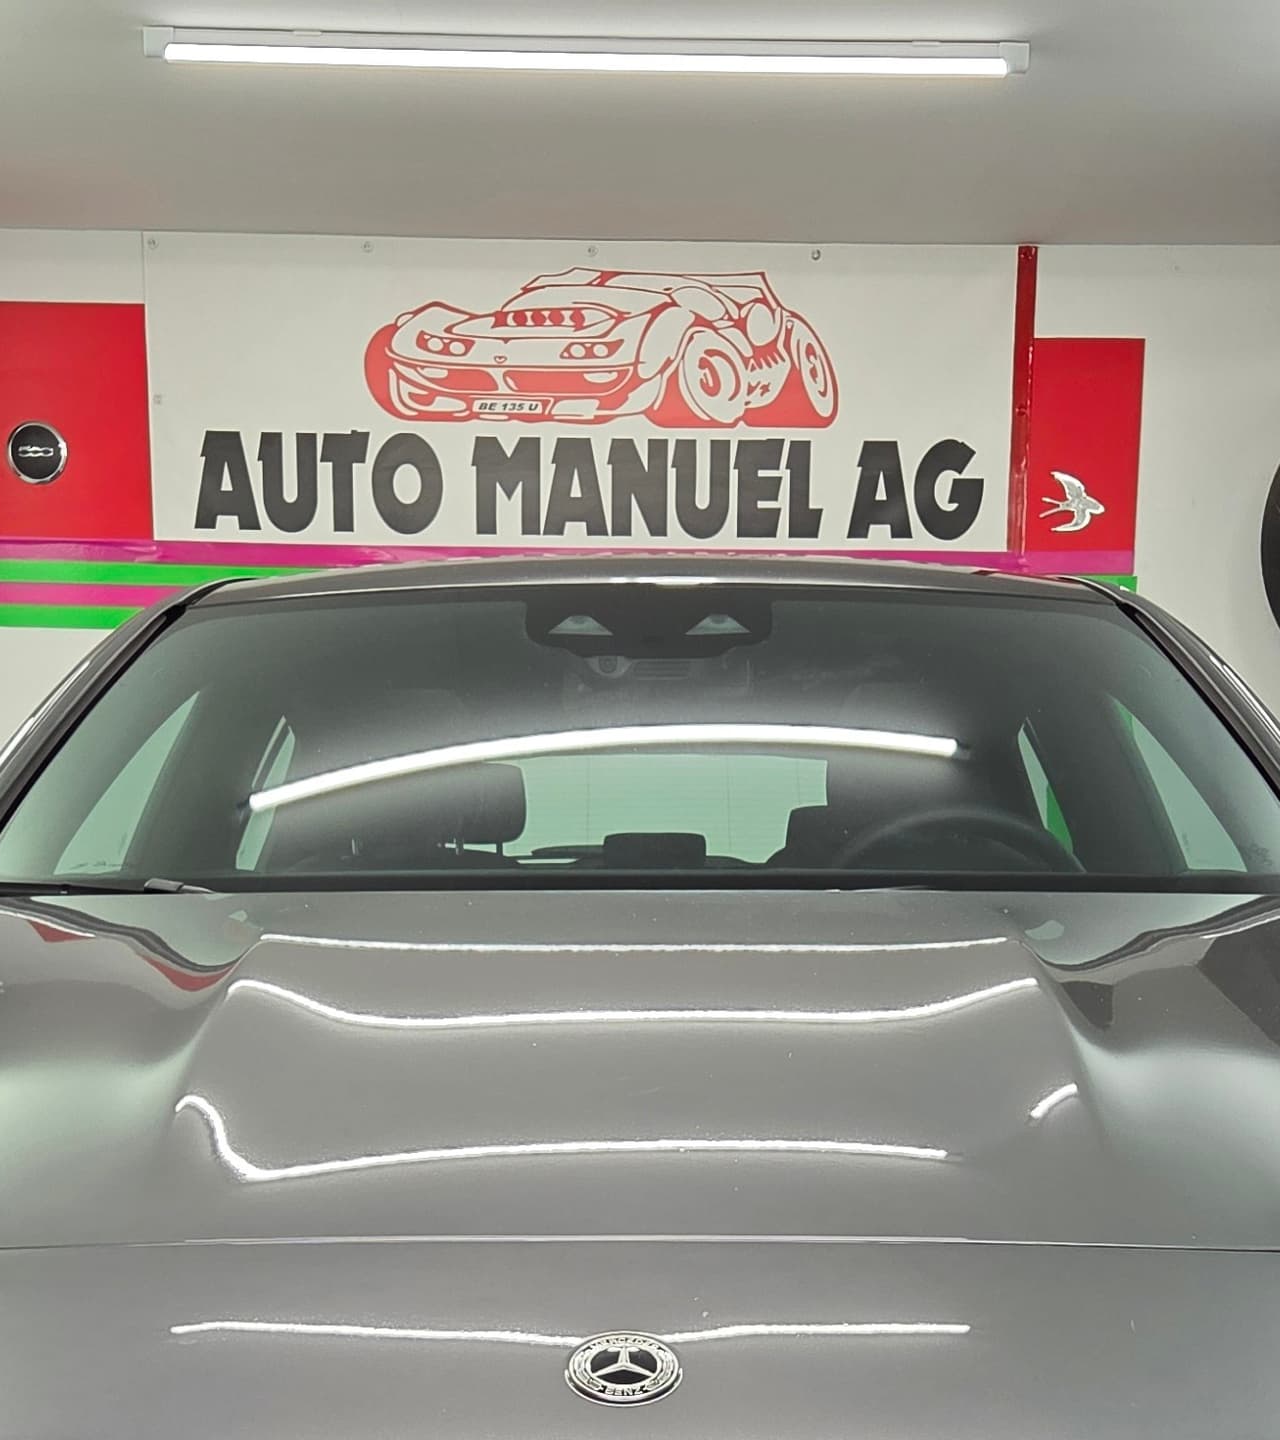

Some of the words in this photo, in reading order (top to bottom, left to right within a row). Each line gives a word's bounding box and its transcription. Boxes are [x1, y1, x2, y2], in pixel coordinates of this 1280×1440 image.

[478, 402, 497, 411] BE
[502, 402, 525, 411] 135
[528, 402, 539, 411] U
[194, 428, 444, 535] AUTO
[471, 436, 824, 540] MANUEL
[846, 438, 985, 541] AG
